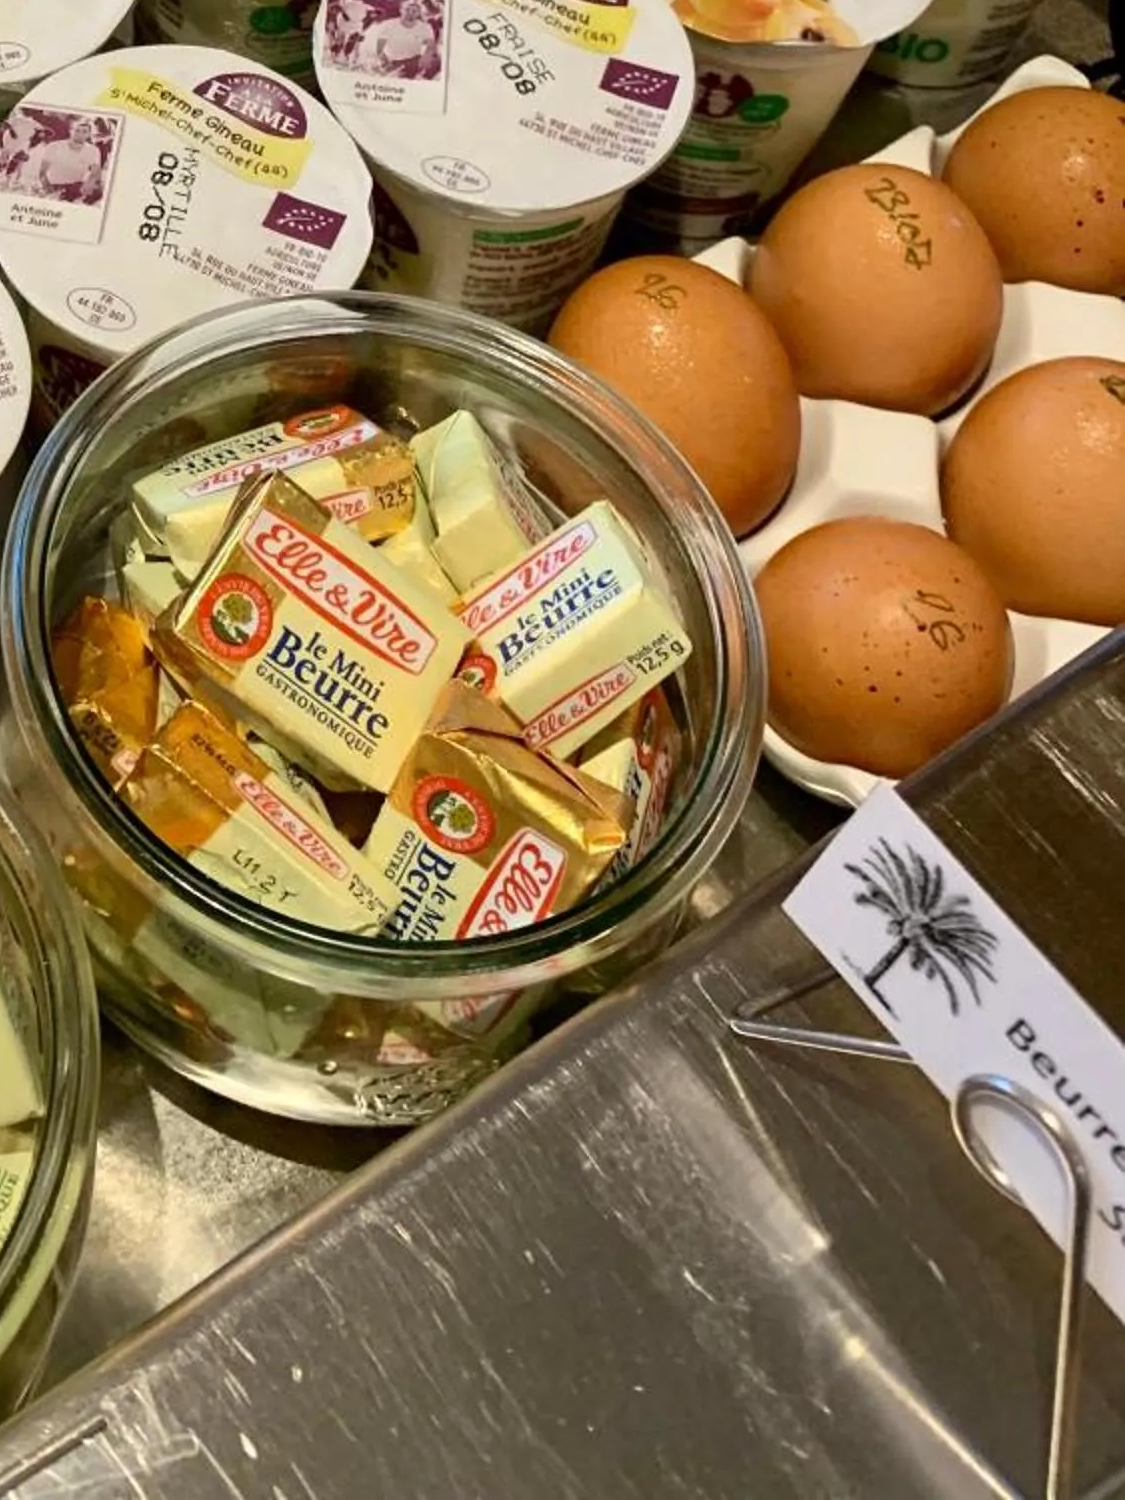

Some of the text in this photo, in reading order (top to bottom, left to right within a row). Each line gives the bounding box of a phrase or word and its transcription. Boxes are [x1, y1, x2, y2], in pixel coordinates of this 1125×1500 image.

[463, 17, 536, 97] 08/08
[485, 12, 556, 83] FRAISE
[146, 81, 265, 157] Ferme Gineau
[203, 81, 300, 137] FERME
[10, 202, 62, 219] Antoine
[27, 216, 59, 229] June
[139, 152, 178, 243] 08/08
[159, 147, 201, 258] MYRTILLE
[255, 525, 421, 663] Elle & Vire
[519, 532, 586, 589] Vire
[497, 568, 614, 664] Beurre
[517, 569, 592, 632] le Mini
[266, 627, 389, 738] Beurre
[304, 631, 385, 702] le Mini
[634, 651, 666, 675] 12,5
[256, 666, 377, 758] GASTRONOMIQUE
[527, 672, 627, 744] Elle Vire
[240, 774, 343, 875] Elle Vire
[496, 845, 555, 913] Elle
